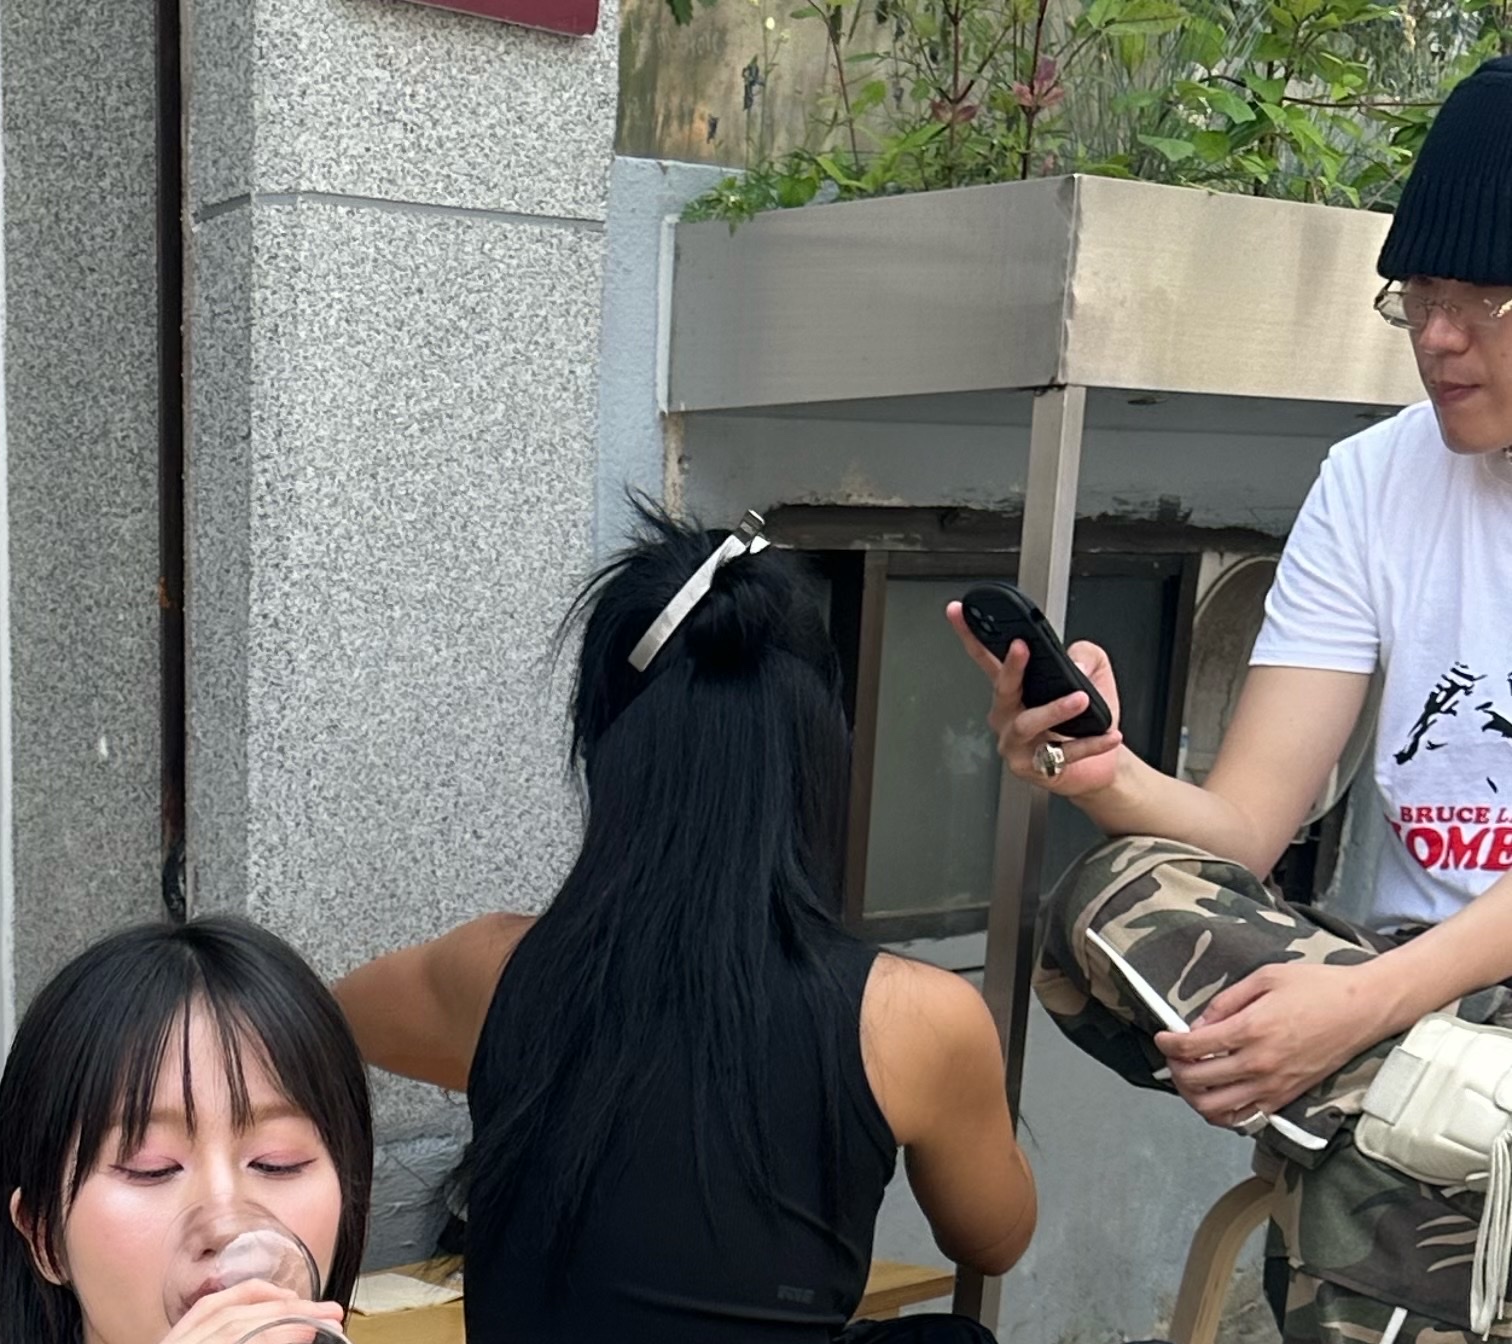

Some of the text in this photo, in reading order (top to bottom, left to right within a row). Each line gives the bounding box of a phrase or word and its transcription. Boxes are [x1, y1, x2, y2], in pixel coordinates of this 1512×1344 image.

[1400, 805, 1512, 824] BRUCE L
[1384, 814, 1512, 871] OME
